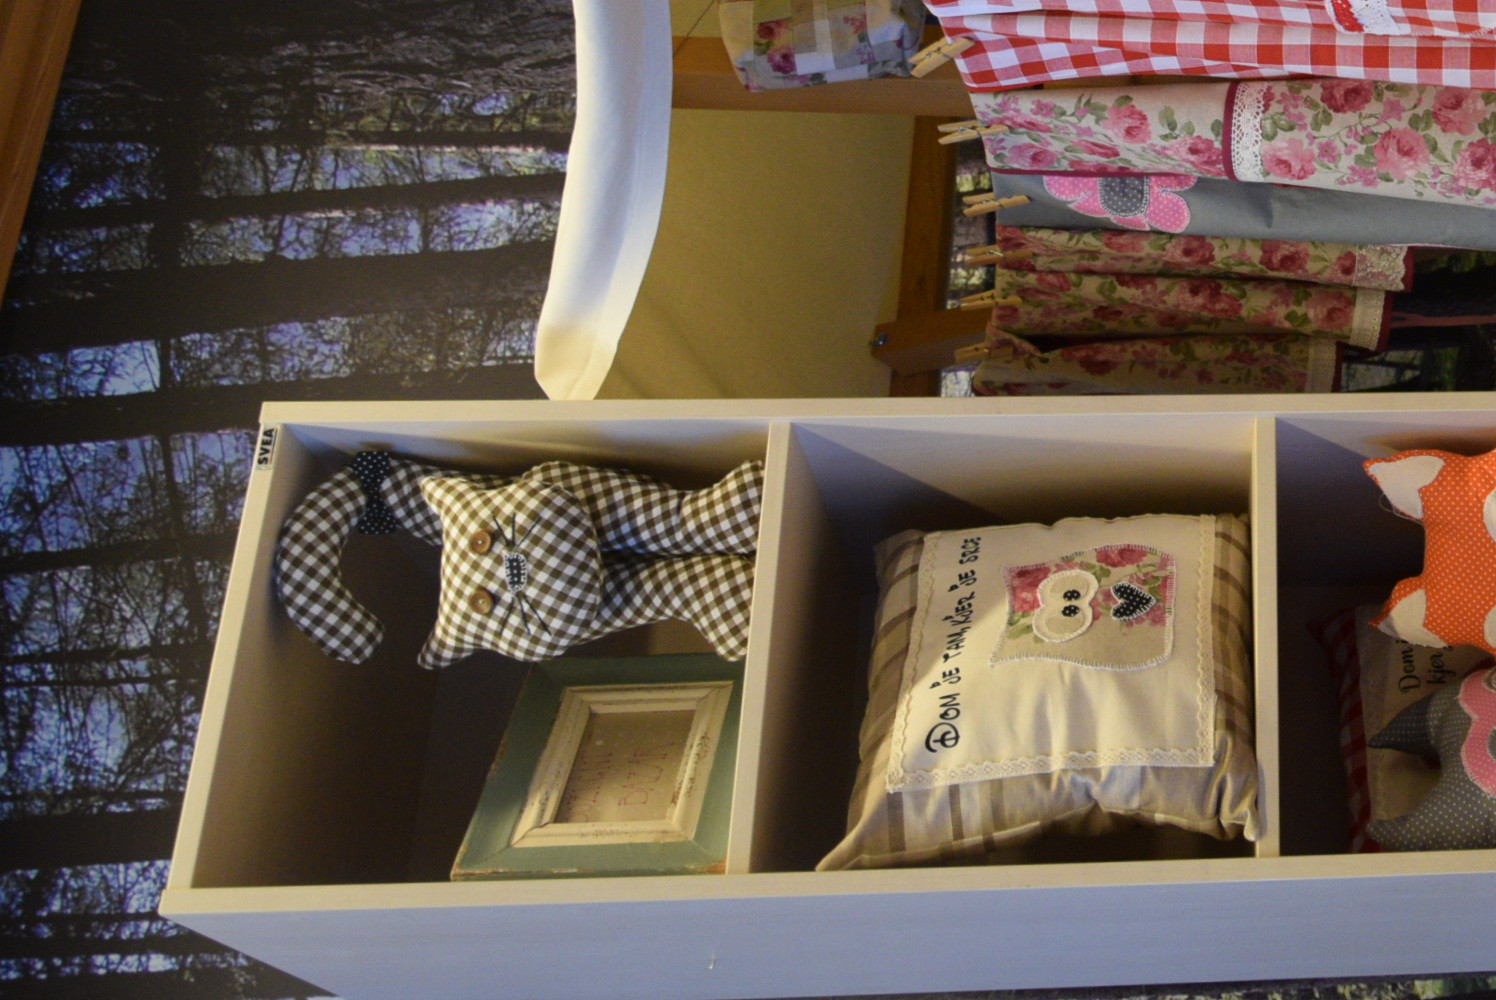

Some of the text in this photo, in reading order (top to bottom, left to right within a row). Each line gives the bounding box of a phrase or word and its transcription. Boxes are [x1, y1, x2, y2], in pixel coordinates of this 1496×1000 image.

[257, 428, 275, 465] SVEA
[1398, 648, 1421, 693] Dom
[1427, 652, 1456, 685] kjer
